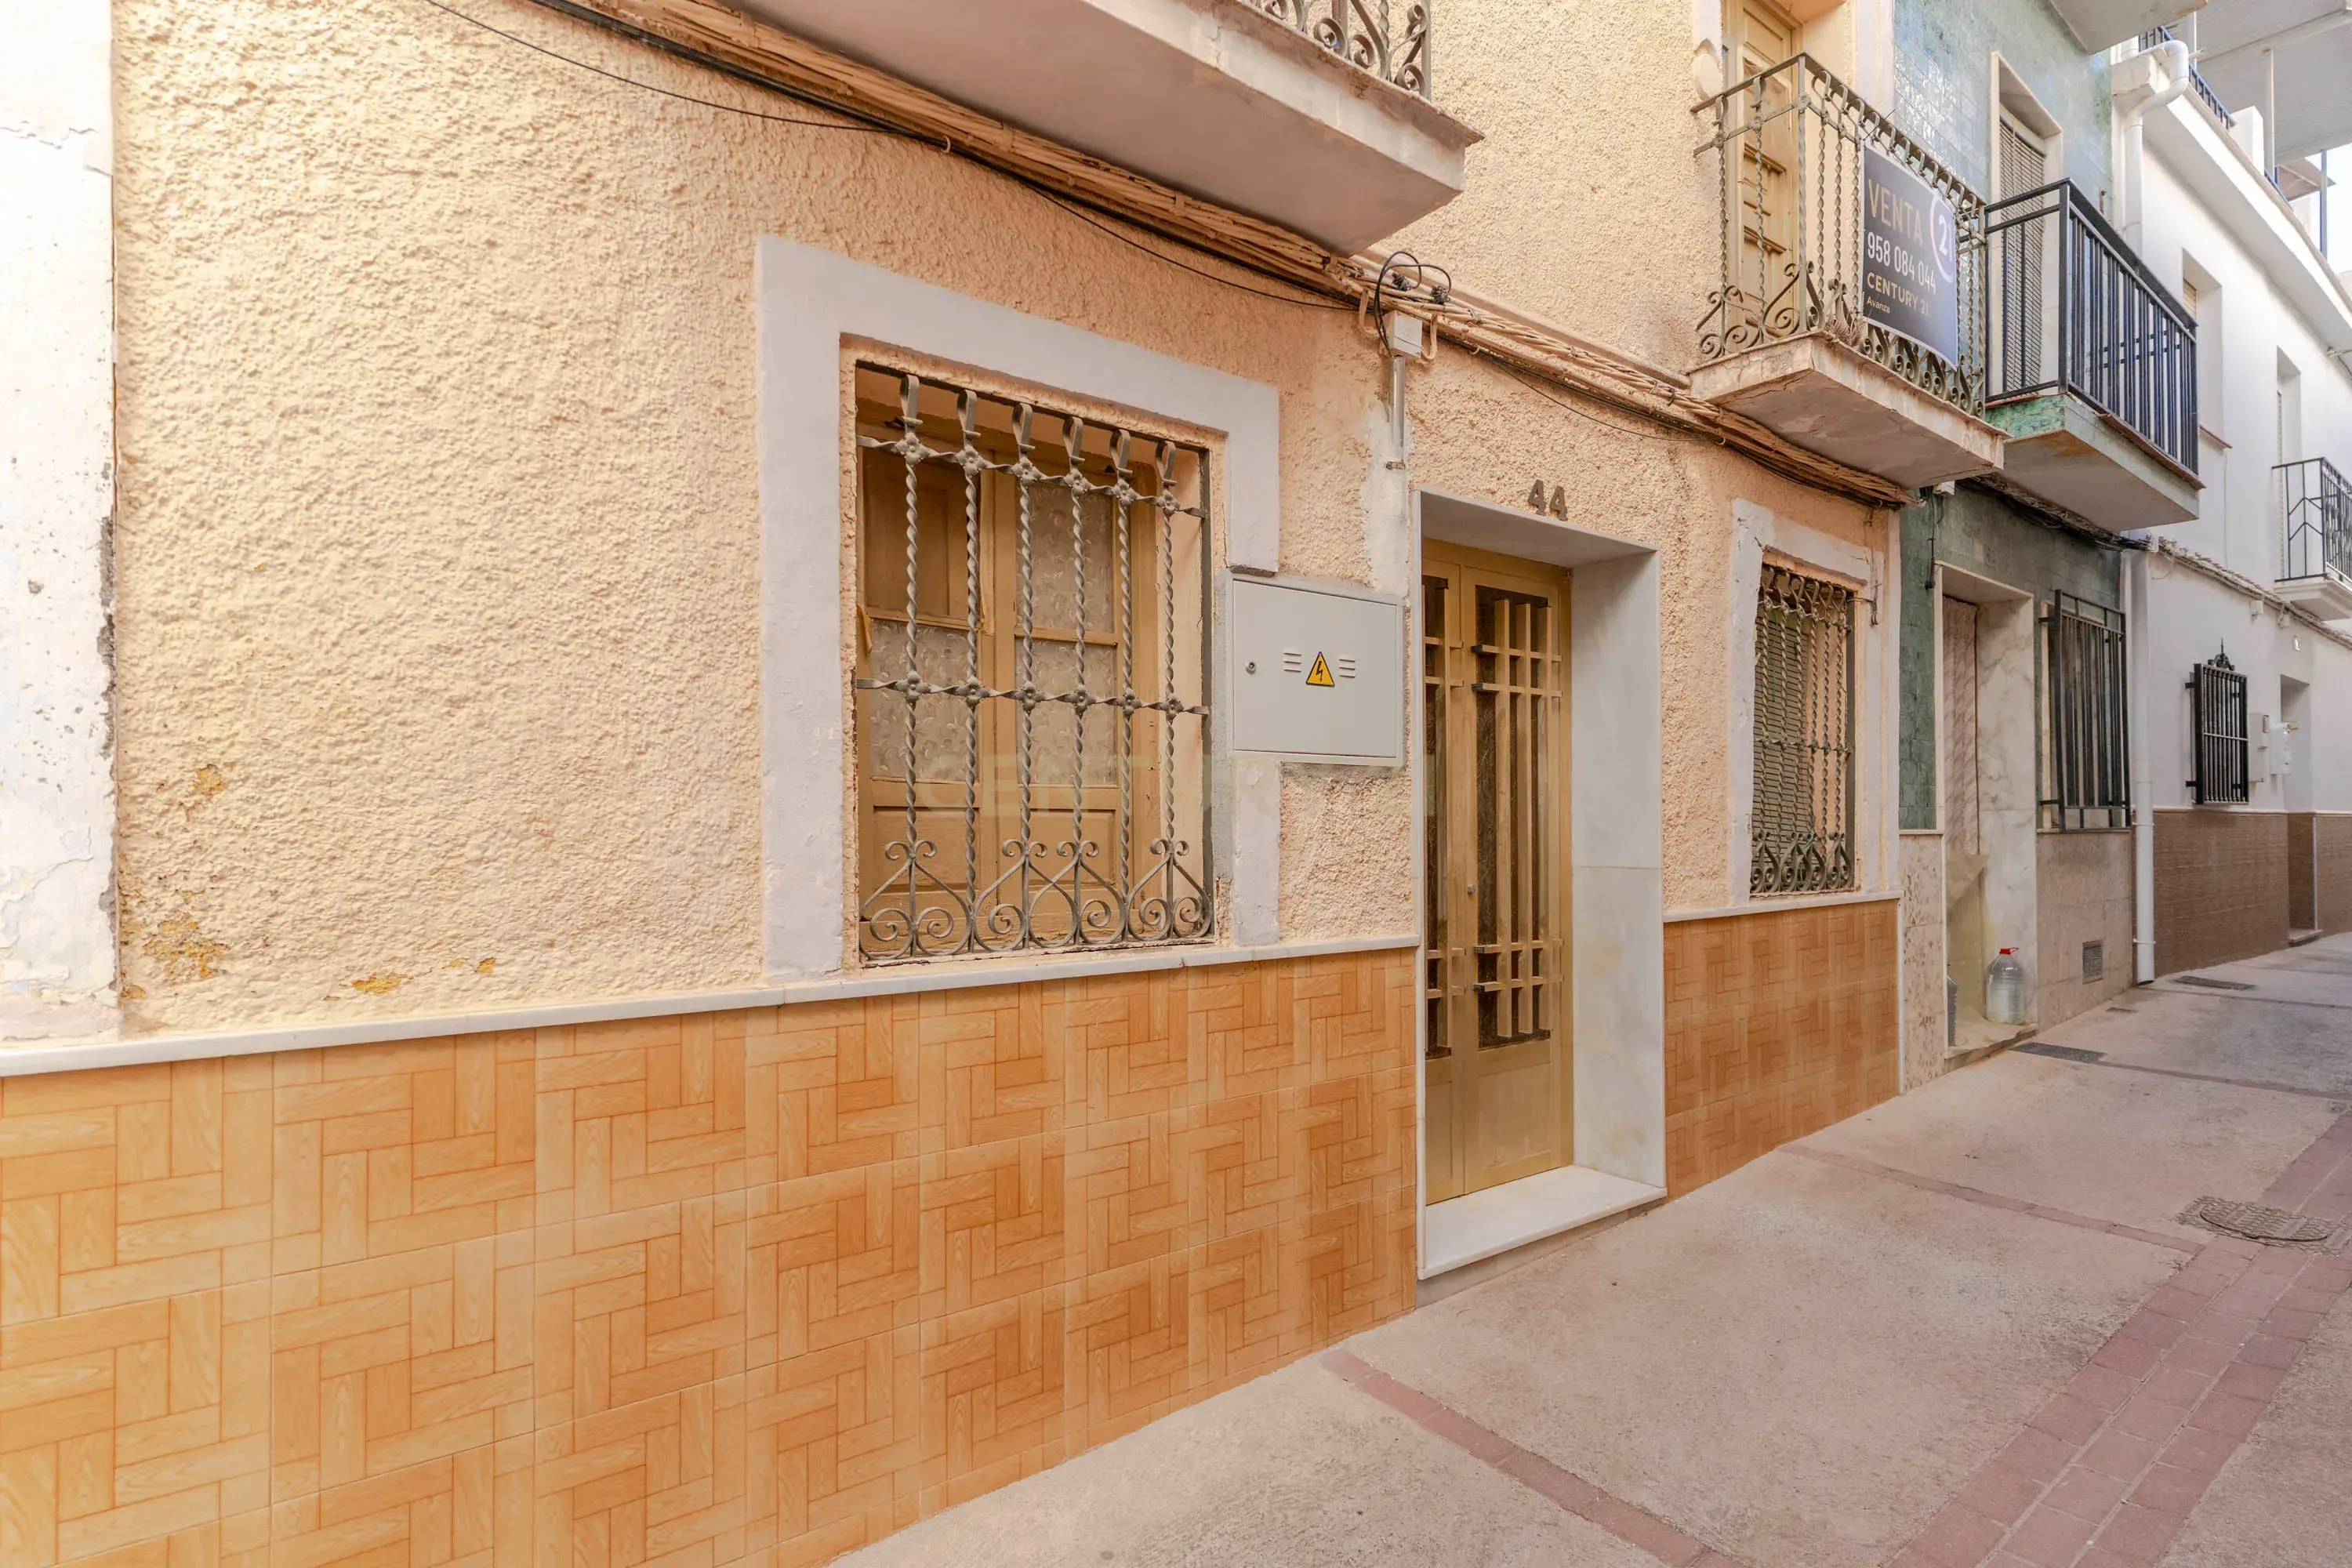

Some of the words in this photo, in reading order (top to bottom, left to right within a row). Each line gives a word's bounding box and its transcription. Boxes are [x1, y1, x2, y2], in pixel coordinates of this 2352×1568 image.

[1867, 178, 1923, 248] VENTA
[1867, 231, 1891, 267] 958
[1894, 245, 1915, 281] 084
[1918, 260, 1936, 295] 044
[1867, 271, 1918, 310] CENTURY
[1867, 296, 1890, 314] Avanza
[1527, 479, 1569, 521] 44
